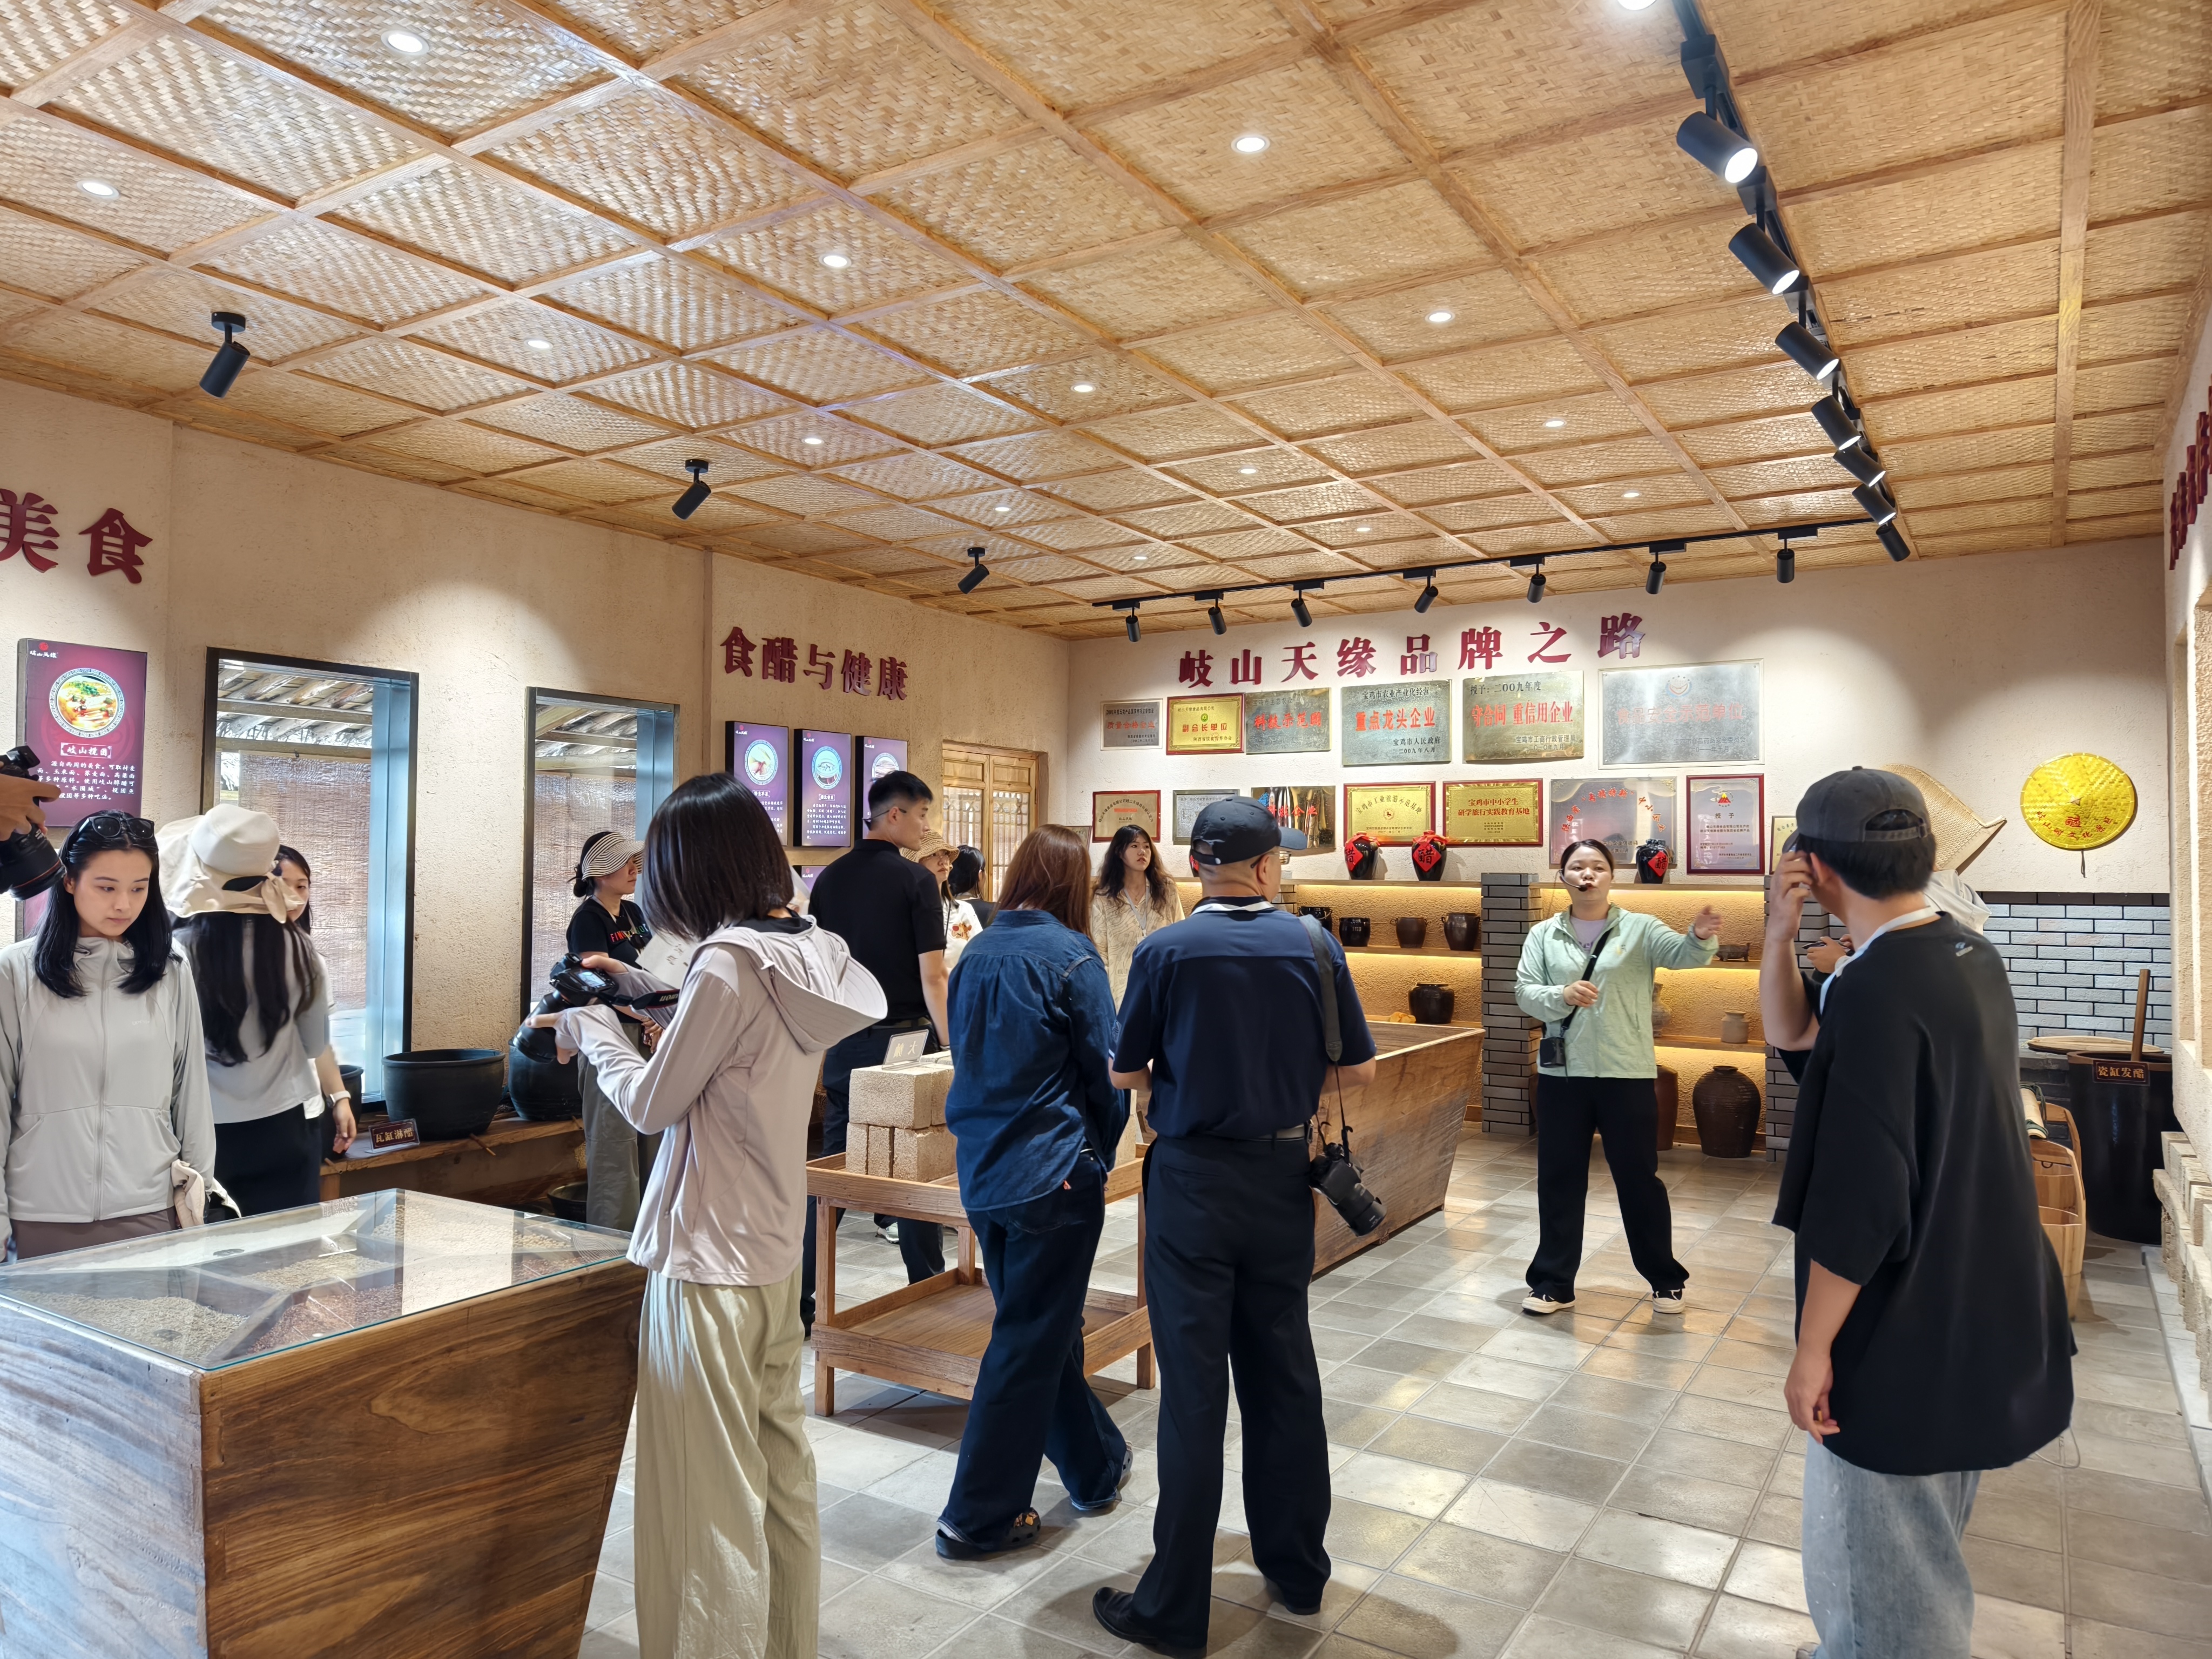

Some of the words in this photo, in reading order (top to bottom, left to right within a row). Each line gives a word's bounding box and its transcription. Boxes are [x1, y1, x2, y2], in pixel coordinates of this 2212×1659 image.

[0, 488, 153, 584] 美食
[1179, 612, 1645, 689] 岐山天缘品牌之路
[720, 626, 908, 700] 食醋与健康
[1362, 686, 1429, 700] 宝鸡市农业产业化经营
[1355, 706, 1435, 732] 重点龙头企业
[1471, 704, 1506, 728] 守合同
[1513, 701, 1573, 725] 重信用企业
[1616, 702, 1744, 725] 食品安全示范单位
[1182, 723, 1228, 732] 副会长单位
[1393, 736, 1441, 746] 宝鸡市人民政府
[1516, 734, 1576, 744] 宝鸡市工商行政管理局
[66, 745, 108, 757] 岐山搅团
[1355, 795, 1422, 815] 宝鸡市工业旅游示范基地
[1468, 798, 1519, 806] 宝鸡市中小学生
[1458, 807, 1530, 816] 研学旅行实践教育基地
[1418, 848, 1435, 865] 醋
[1655, 855, 1667, 869] 醋
